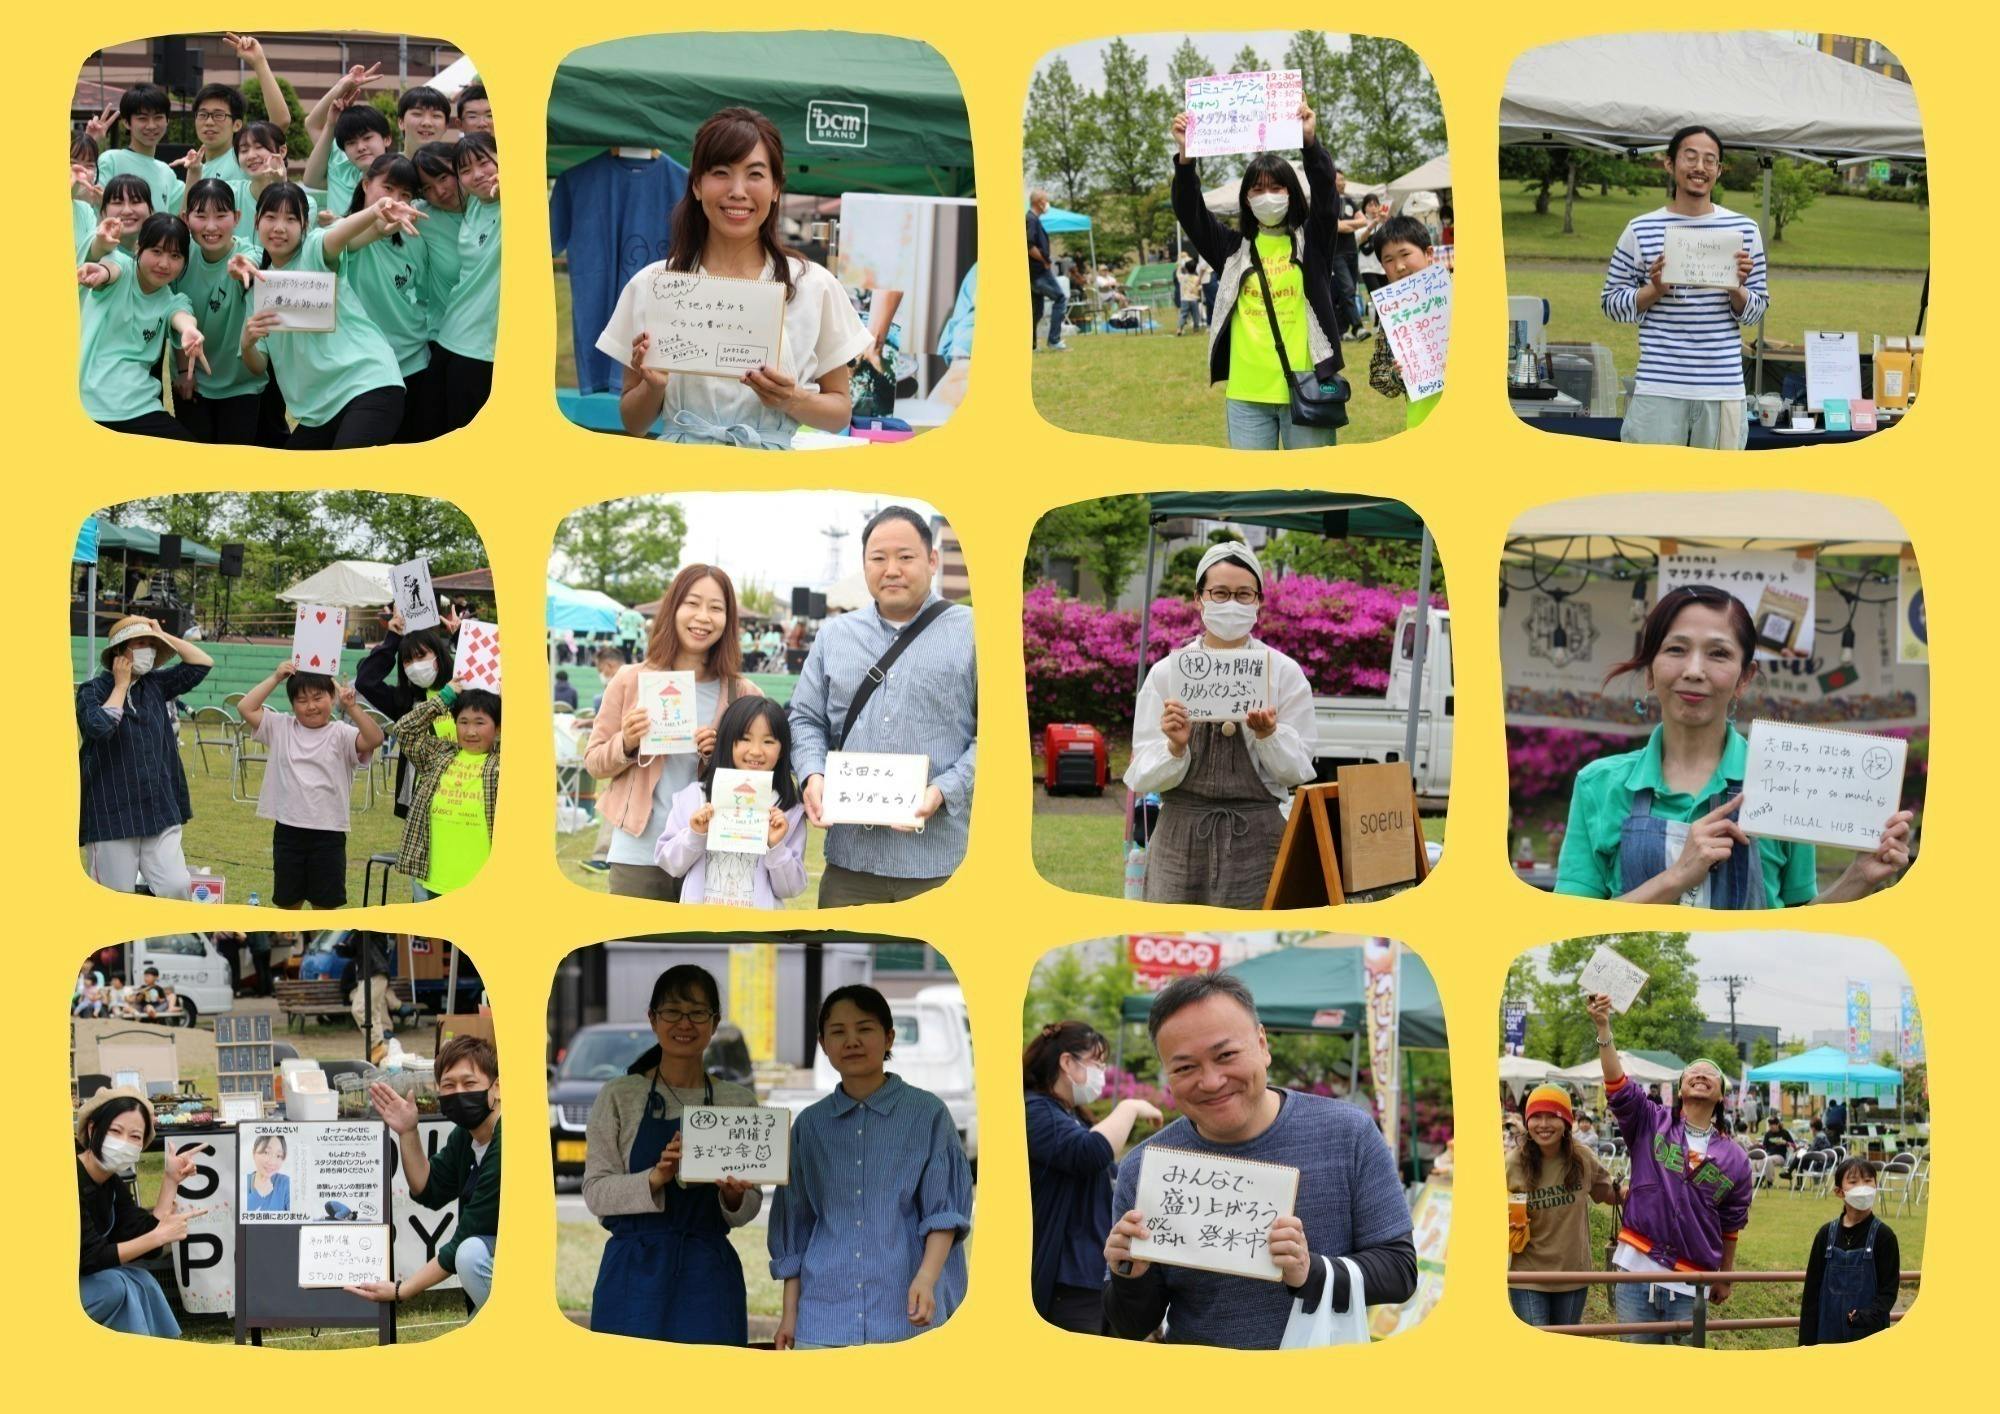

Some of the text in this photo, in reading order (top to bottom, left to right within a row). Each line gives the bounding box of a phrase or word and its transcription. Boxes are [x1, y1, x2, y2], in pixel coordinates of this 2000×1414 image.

[1190, 79, 1264, 96] コミュニケーショ
[818, 130, 856, 139] BRAND
[1668, 568, 1789, 583] マサラチャイのキット
[1213, 658, 1263, 676] 初開催
[840, 761, 893, 776] 志田さん
[441, 788, 479, 800] estival
[1760, 778, 1873, 802] Thank yo so much
[839, 791, 917, 808] ありがとう!
[1360, 810, 1403, 835] soeru
[1783, 814, 1824, 829] HALAL
[1830, 821, 1854, 833] HUB
[720, 1113, 776, 1128] とめまる
[254, 1126, 299, 1134] ごめんなさい!
[729, 1127, 771, 1141] 開催!
[328, 1150, 367, 1158] もしよかったら
[1162, 1165, 1254, 1192] みんなで
[241, 1212, 310, 1220] 只今店頭におりません
[1160, 1188, 1278, 1229] 盛り上がろう
[1146, 1216, 1172, 1231] がん
[1153, 1233, 1187, 1247] ばれ
[1198, 1224, 1268, 1259] 登米市
[308, 1272, 343, 1281] STUDIO
